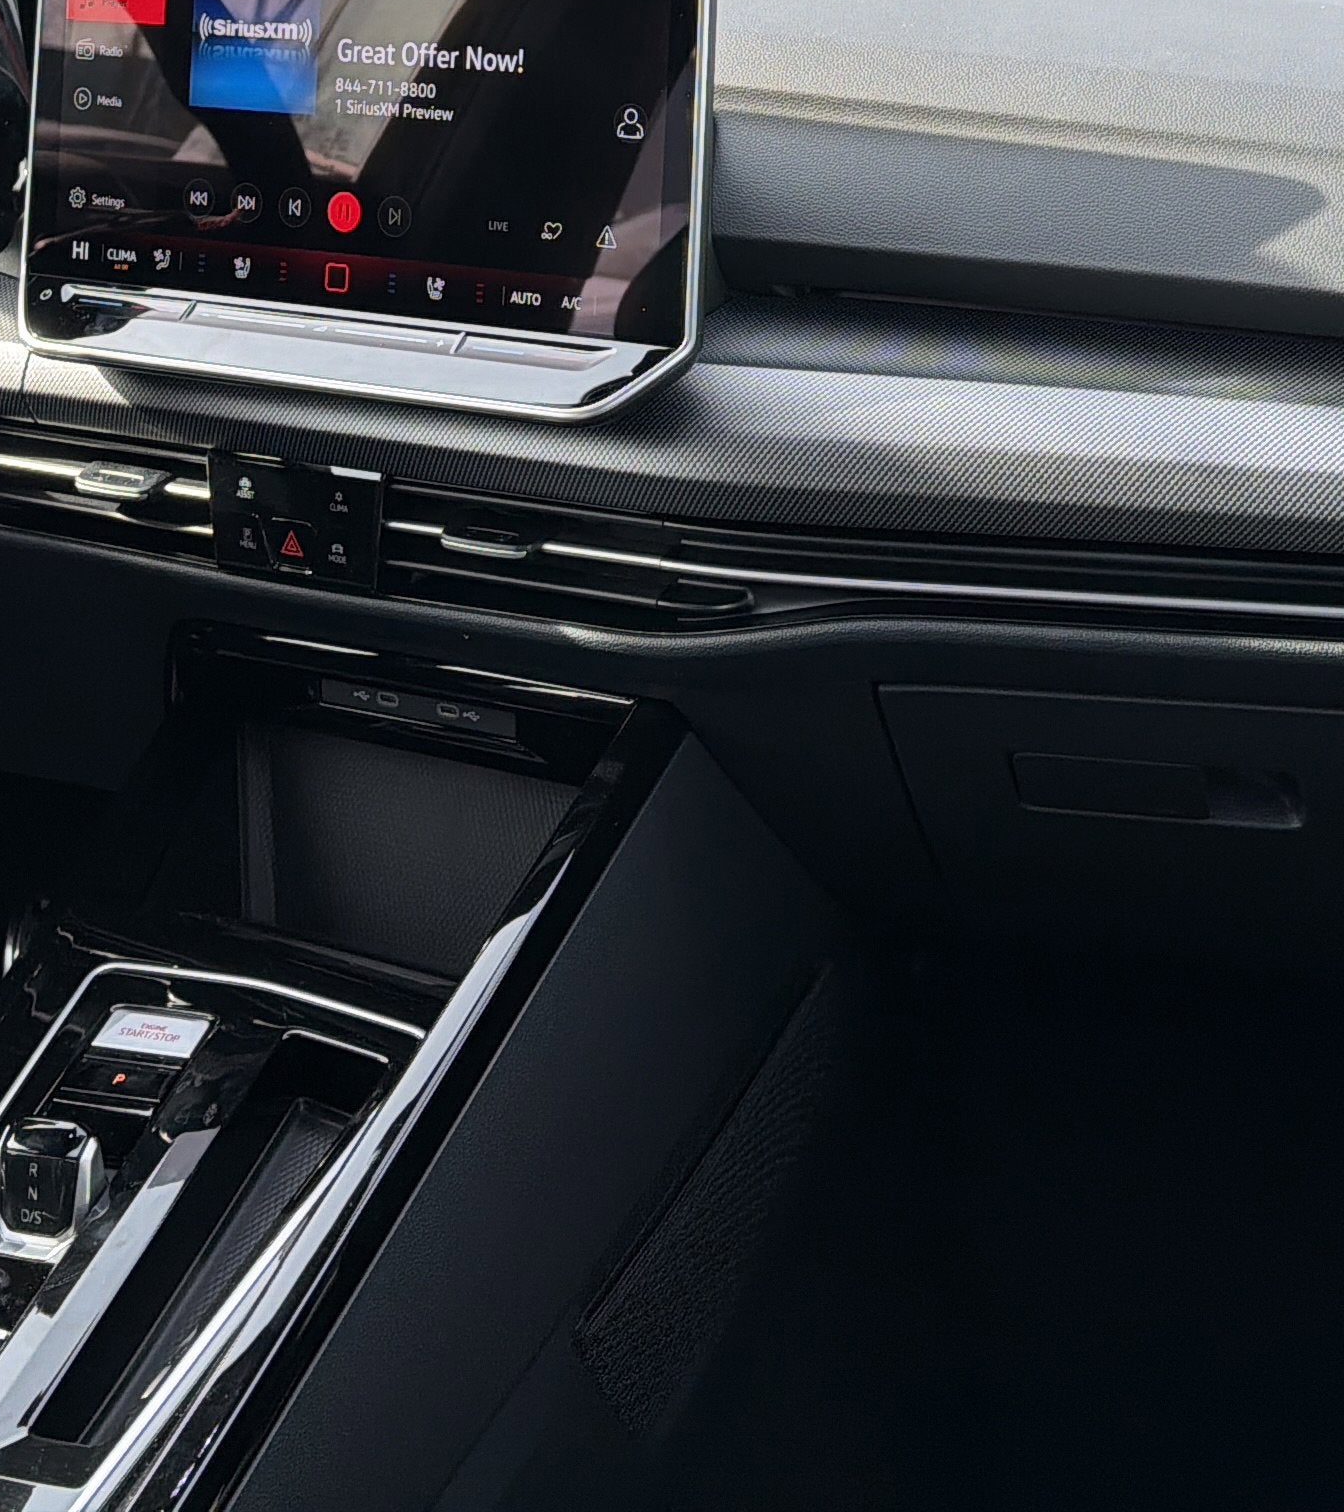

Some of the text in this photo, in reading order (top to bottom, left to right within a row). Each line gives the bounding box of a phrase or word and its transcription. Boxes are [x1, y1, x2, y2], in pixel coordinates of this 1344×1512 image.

[99, 45, 124, 58] Radio
[337, 38, 525, 75] Great Offer Now!
[335, 77, 437, 100] 844-711-8800
[96, 95, 123, 108] Media
[346, 100, 400, 118] SiriusXM
[401, 103, 454, 122] Preview
[91, 194, 126, 209] Settings
[488, 220, 509, 233] LIVE
[71, 240, 90, 261] HI
[106, 248, 138, 263] CLIMA
[509, 291, 583, 311] AUTO A/C
[329, 503, 349, 513] CLIMA
[240, 540, 257, 550] MENU
[328, 554, 347, 565] MODE
[140, 1022, 169, 1032] ENGINE
[118, 1027, 181, 1043] START/STOP
[112, 1073, 127, 1085] P
[29, 1162, 38, 1178] R
[27, 1186, 38, 1201] N
[20, 1208, 42, 1225] D/S
